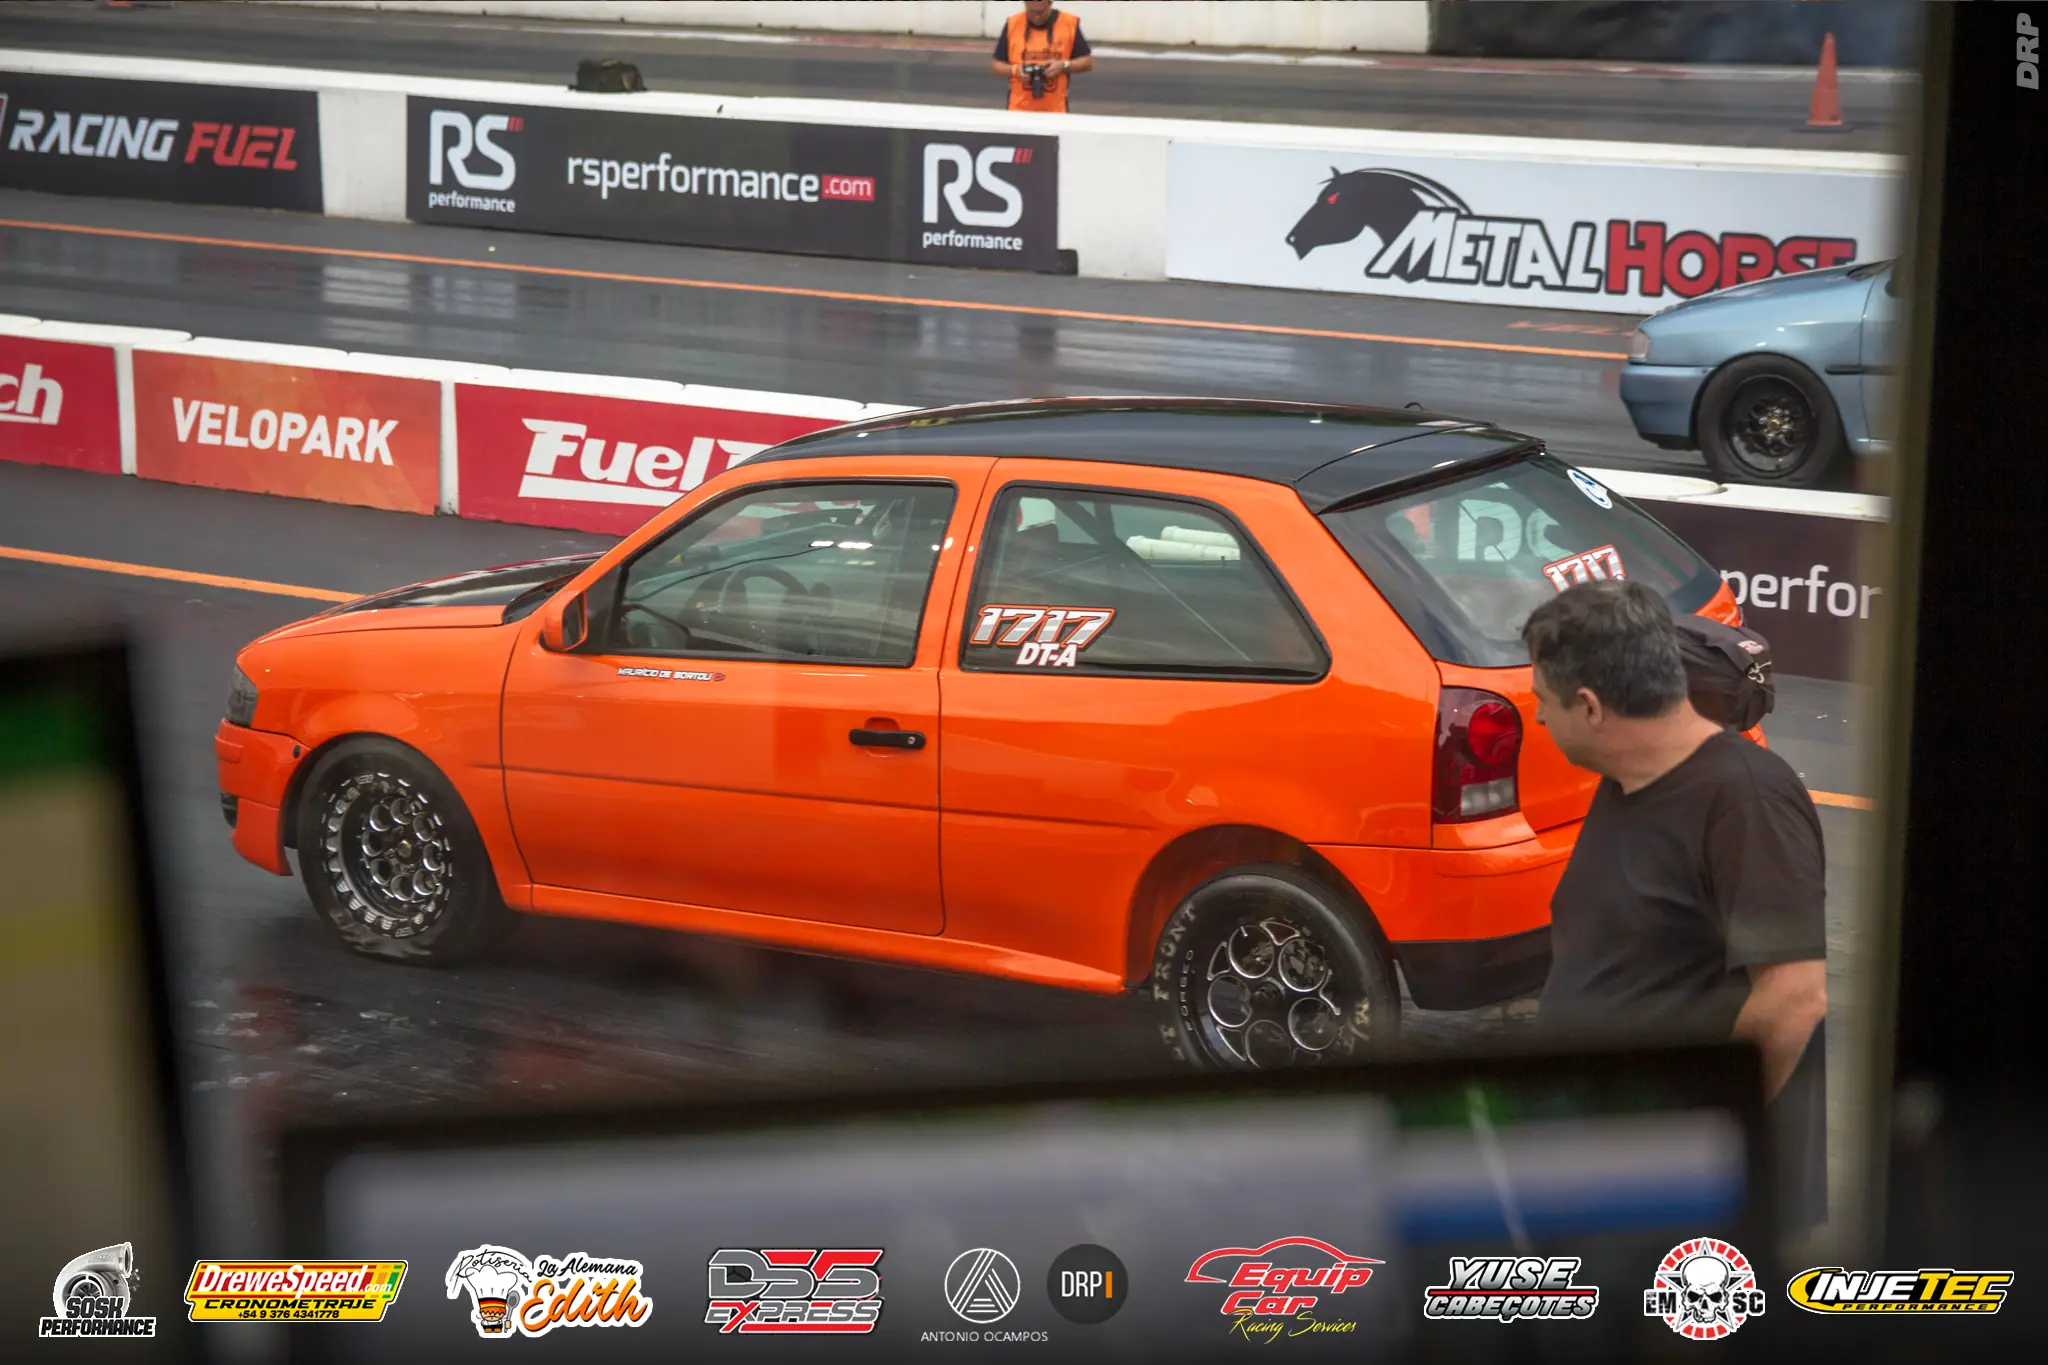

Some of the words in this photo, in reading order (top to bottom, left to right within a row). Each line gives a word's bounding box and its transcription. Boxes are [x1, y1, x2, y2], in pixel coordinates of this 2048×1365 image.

[8, 108, 179, 162] RACING
[184, 121, 298, 171] FUEL
[429, 109, 516, 191] RS
[429, 190, 516, 213] performance
[923, 142, 1023, 228] RS
[923, 229, 1023, 251] performance
[172, 396, 399, 466] VELOPARK
[969, 603, 1116, 649] 1717
[1015, 641, 1078, 668] DT-A
